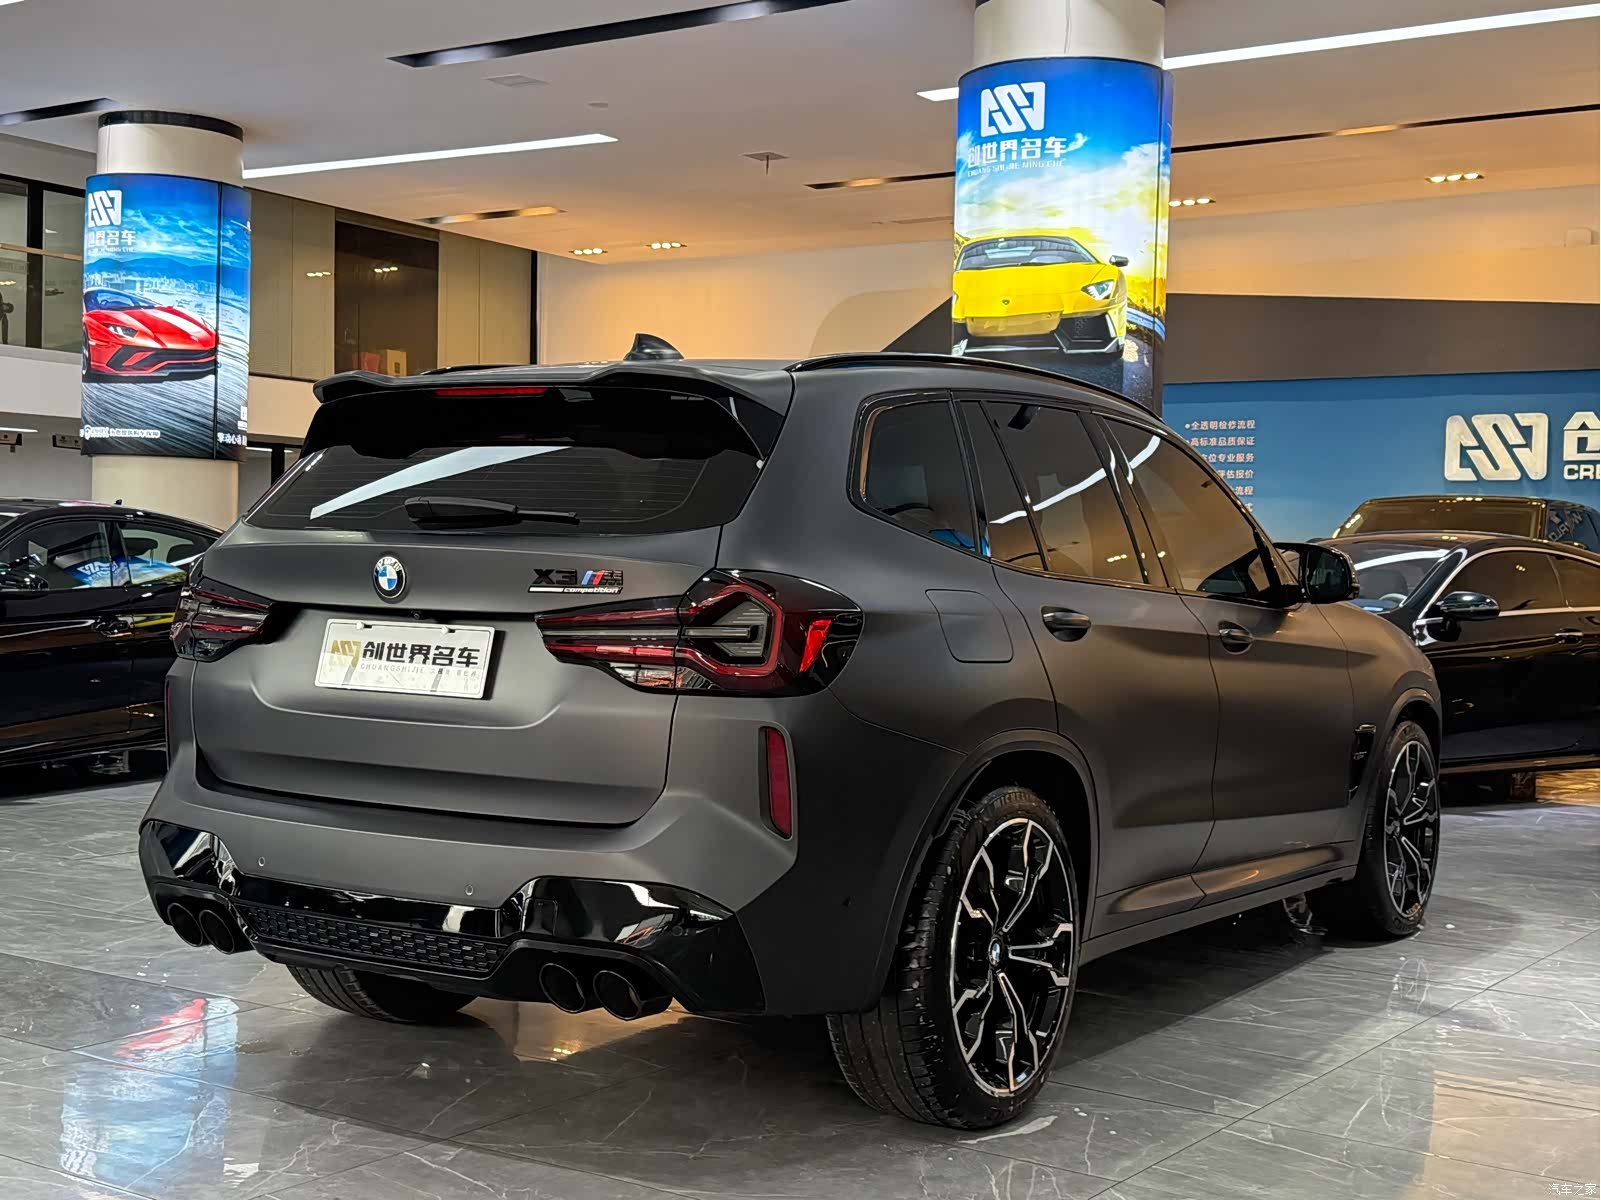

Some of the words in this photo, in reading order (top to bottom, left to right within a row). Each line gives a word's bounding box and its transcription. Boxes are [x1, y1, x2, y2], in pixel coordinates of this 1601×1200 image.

[967, 136, 1067, 168] 创世界名车
[1191, 420, 1255, 430] 全透明检修流程
[1190, 436, 1255, 447] 高标准品质保证
[1232, 485, 1254, 496] 流程
[532, 568, 577, 585] X3
[362, 641, 481, 667] 创世界名车
[360, 662, 425, 675] CHUANGSHIJIE
